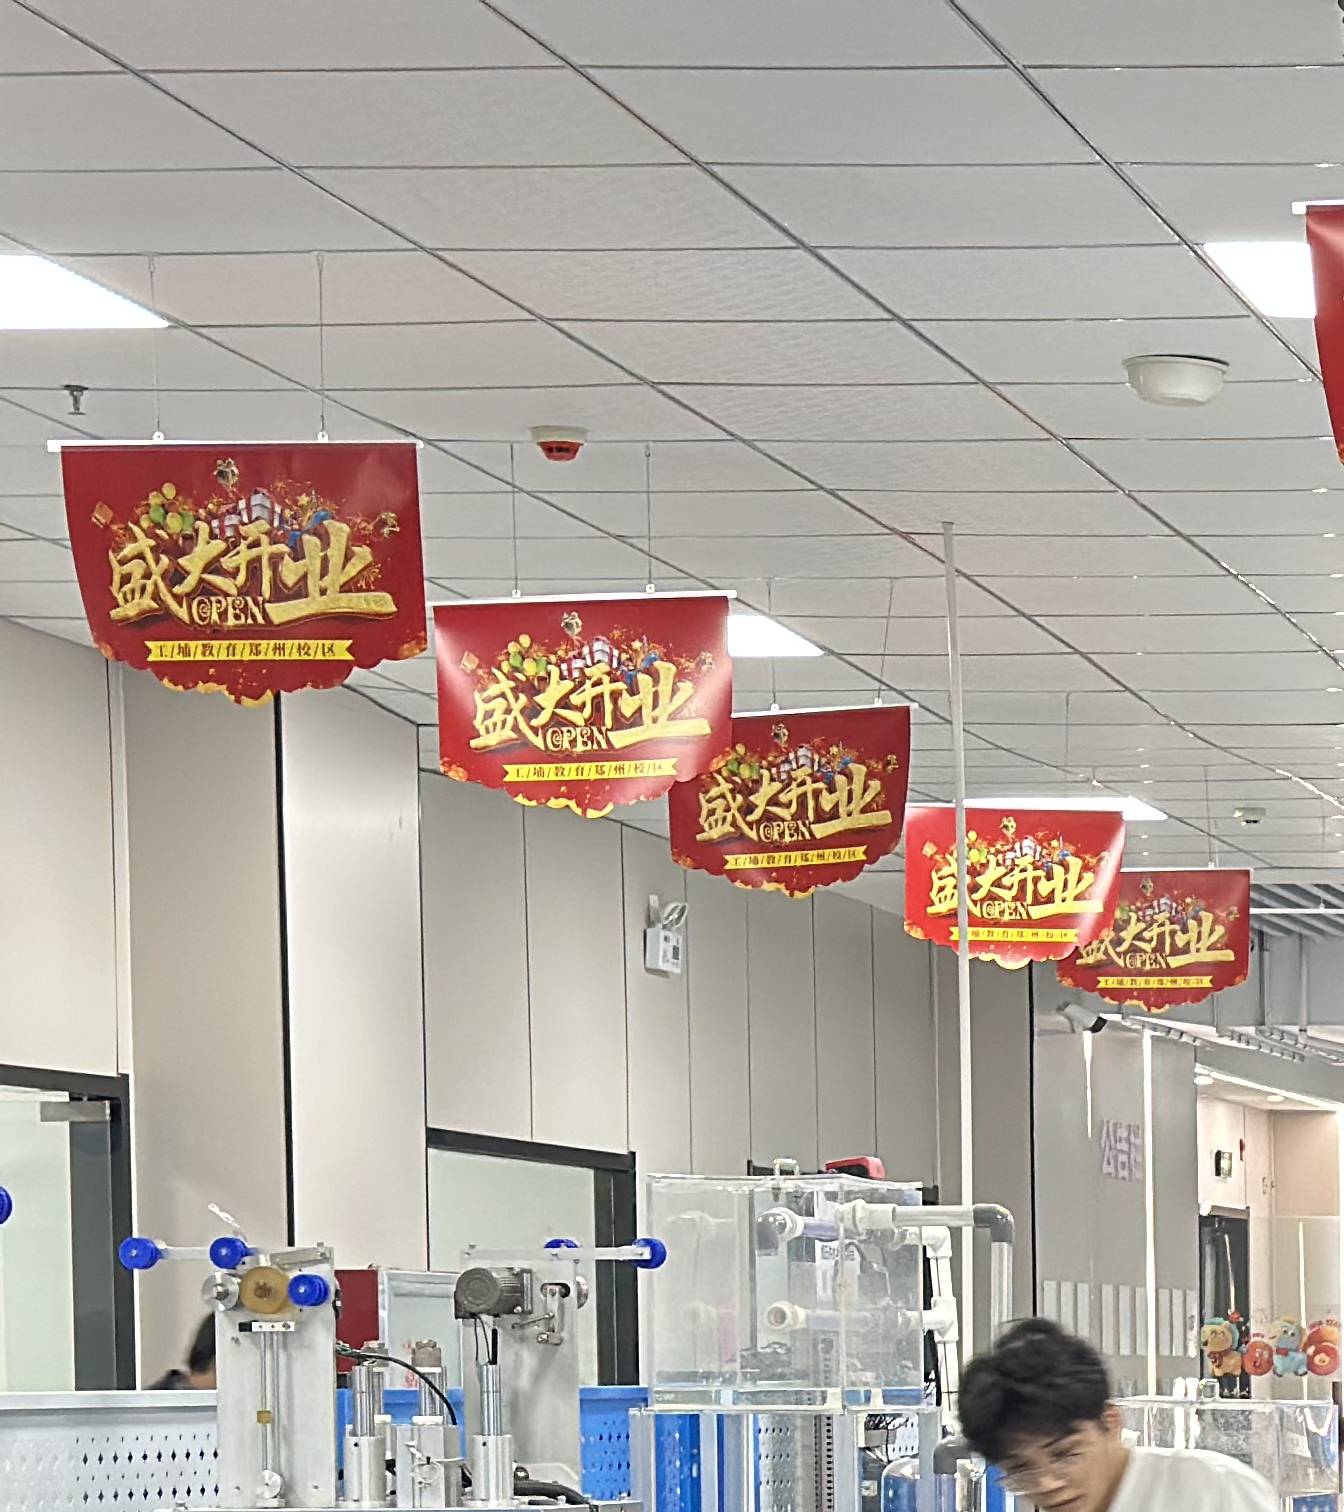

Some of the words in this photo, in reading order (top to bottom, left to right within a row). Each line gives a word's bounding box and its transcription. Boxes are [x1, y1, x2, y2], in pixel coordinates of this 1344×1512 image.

[109, 518, 398, 624] 盛大开业
[191, 595, 267, 625] OPEN
[470, 660, 712, 752] 盛大开业
[545, 726, 609, 752] OPEN
[696, 764, 893, 842] 盛大开业
[759, 820, 812, 843] OPEN
[927, 855, 1104, 918] 盛大开业
[981, 902, 1032, 920] OPEN
[1125, 952, 1168, 970] OPEN
